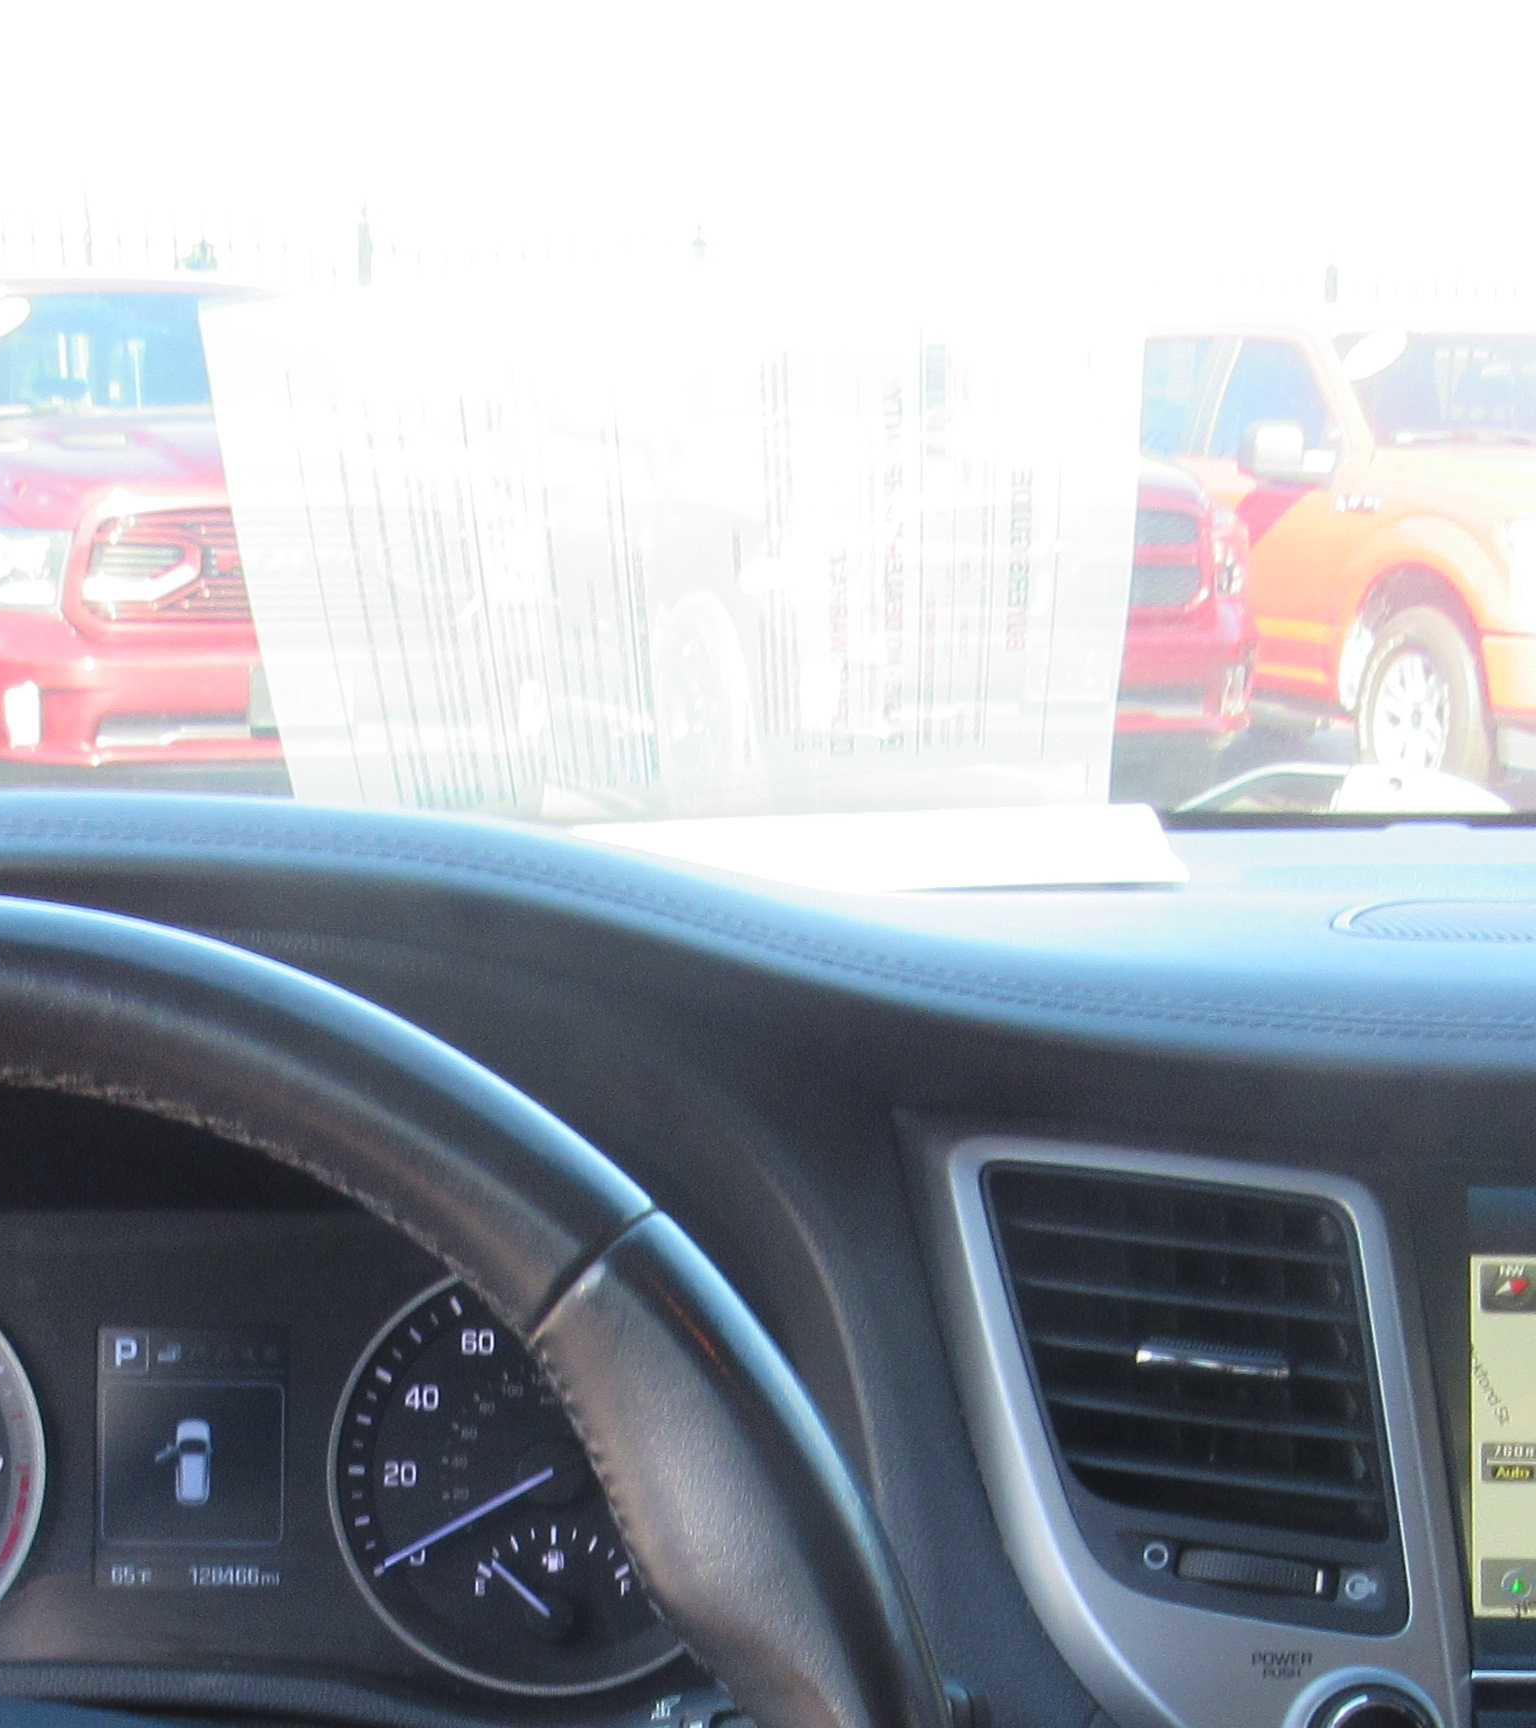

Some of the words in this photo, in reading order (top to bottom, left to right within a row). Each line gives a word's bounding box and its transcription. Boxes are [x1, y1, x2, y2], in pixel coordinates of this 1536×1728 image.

[115, 1337, 139, 1368] P
[460, 1328, 495, 1355] 60
[404, 1384, 440, 1411] 40
[383, 1461, 417, 1488] 20
[1494, 1466, 1531, 1481] Auto
[1251, 1652, 1313, 1667] POWER
